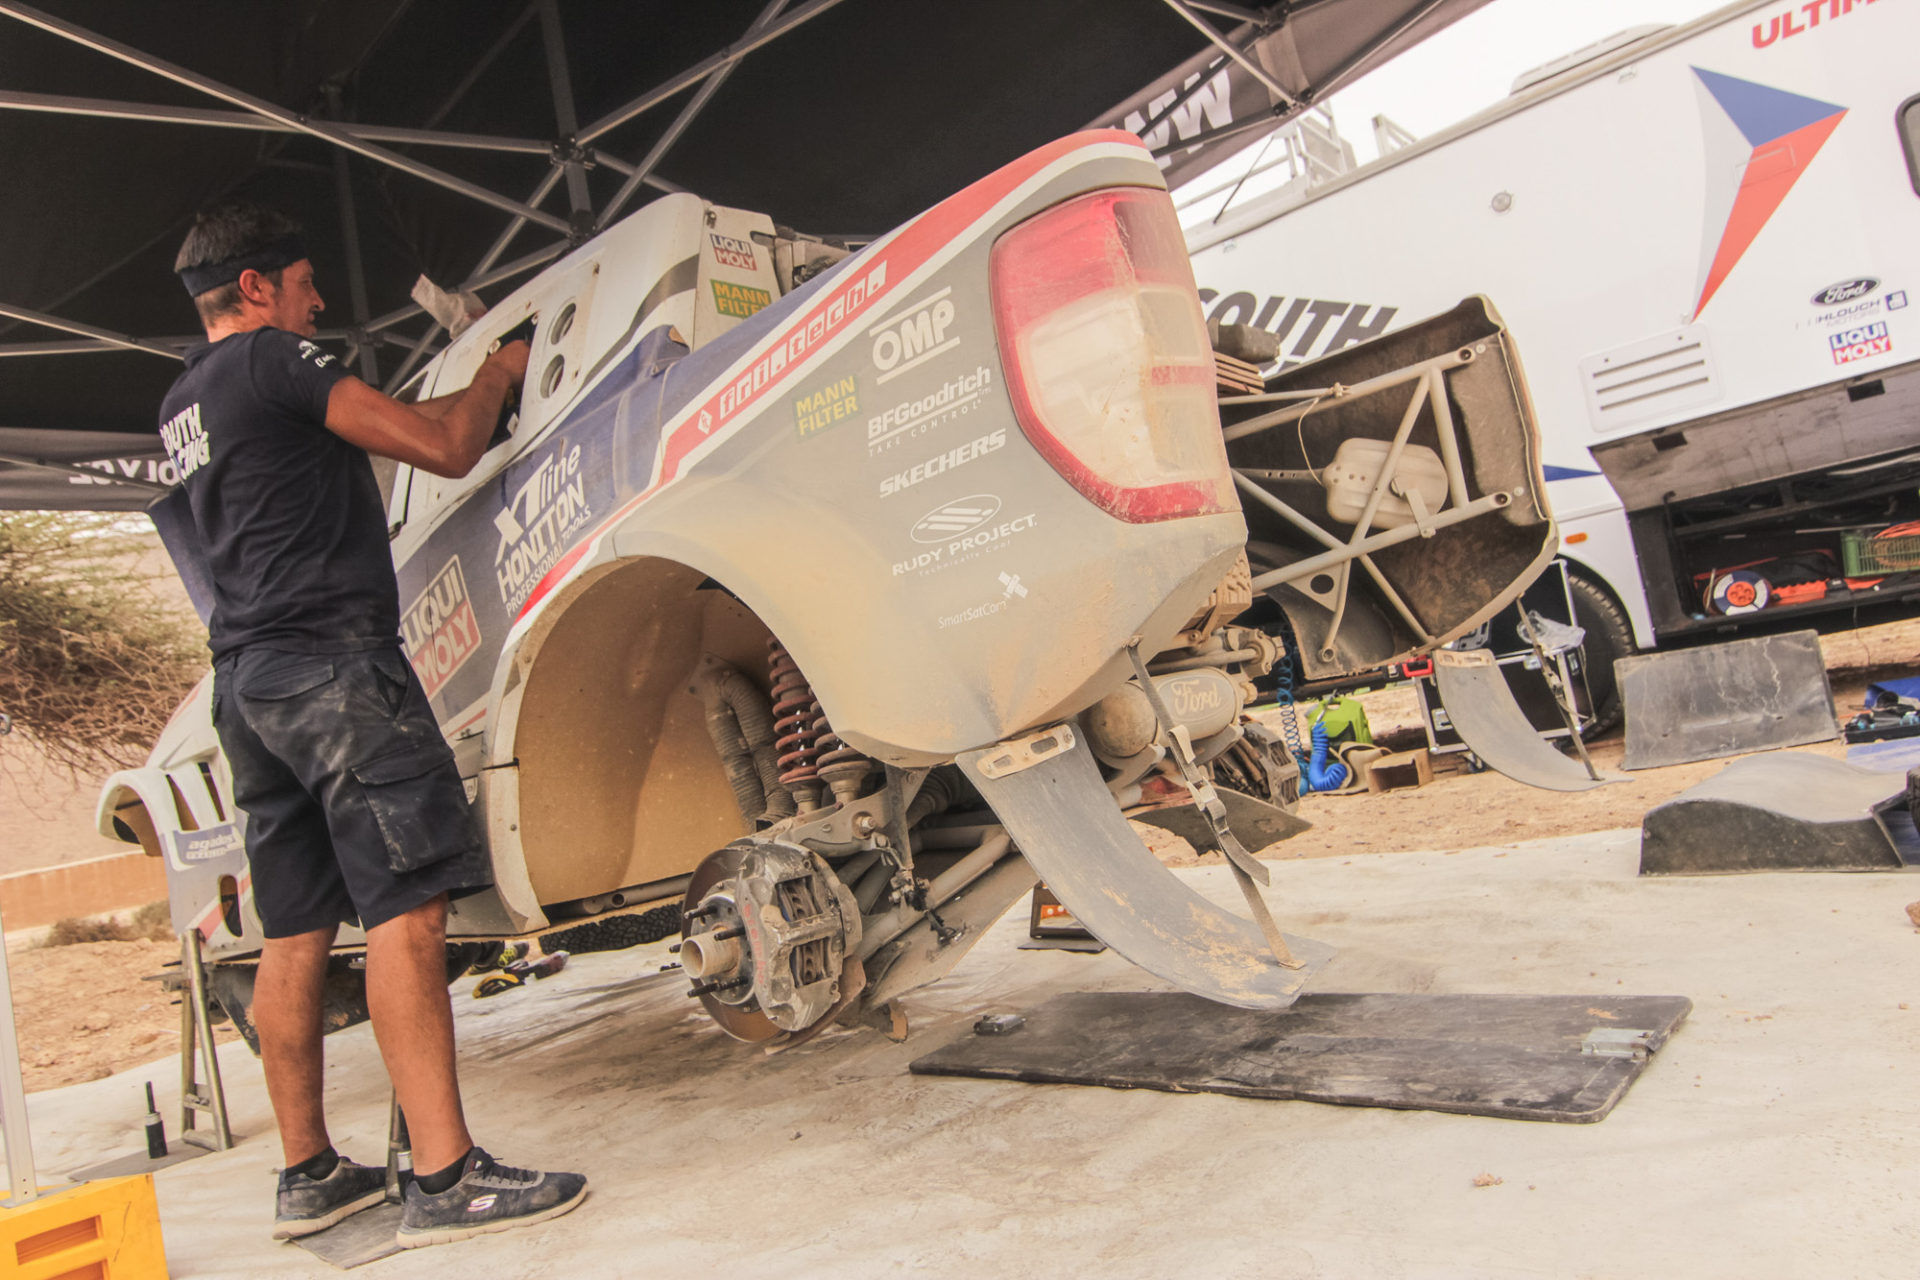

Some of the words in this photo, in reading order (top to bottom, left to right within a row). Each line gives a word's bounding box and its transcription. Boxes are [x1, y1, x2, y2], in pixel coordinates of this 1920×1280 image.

[711, 234, 753, 257] LIQUI
[714, 248, 756, 271] MOLY
[713, 282, 769, 305] MANN
[718, 297, 767, 316] FILTE
[1818, 299, 1881, 323] HLOUCH
[1823, 280, 1868, 304] Ford
[872, 299, 955, 371] OMP
[1830, 321, 1887, 350] LIQUI
[1835, 338, 1890, 364] MOLY
[796, 376, 856, 418] MANN
[799, 395, 859, 436] FILTER
[868, 366, 991, 440] BFGoodrich
[160, 402, 202, 457] OUTH
[869, 437, 901, 458] TAKE
[172, 431, 211, 482] CING
[880, 428, 1007, 499] SKECHERS
[497, 471, 586, 604] HONITON
[505, 541, 563, 617] PROFESSIONAL
[562, 504, 592, 545] TOOLS
[892, 547, 943, 577] RUDY
[402, 565, 464, 657] LIQUI
[413, 605, 473, 695] MOLY
[1170, 680, 1221, 716] Ford
